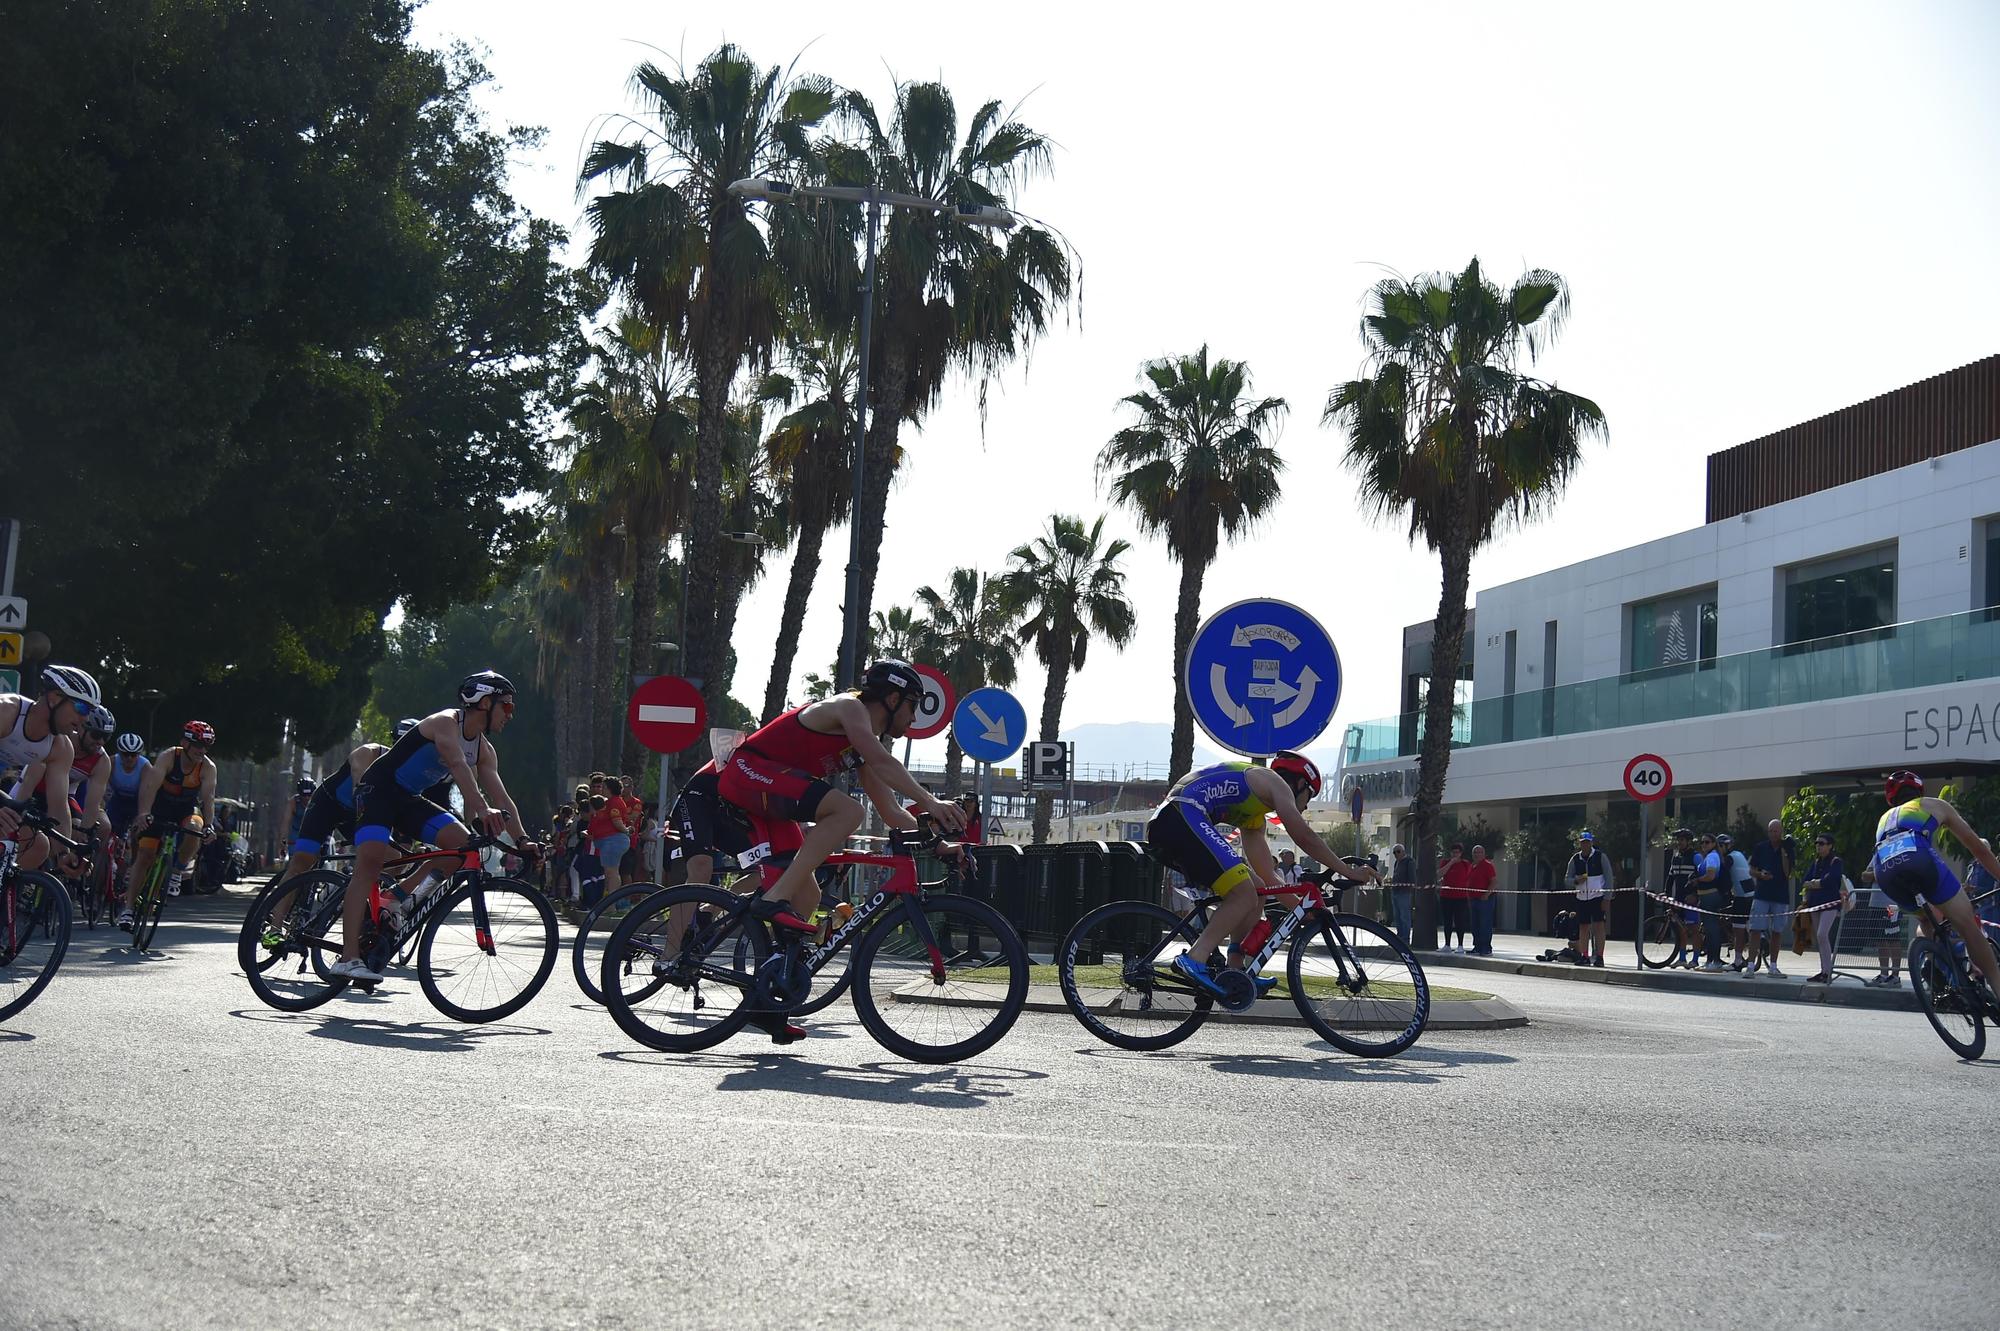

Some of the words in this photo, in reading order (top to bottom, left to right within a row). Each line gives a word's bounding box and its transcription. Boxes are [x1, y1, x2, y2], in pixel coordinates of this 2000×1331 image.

[920, 691, 939, 715] 0
[736, 758, 774, 785] Cartagena
[1034, 743, 1062, 775] P
[1633, 770, 1662, 786] 40
[1130, 824, 1141, 838] P
[747, 848, 761, 862] 30
[1887, 840, 1905, 853] 72
[1882, 854, 1910, 873] JOSE
[393, 875, 454, 946] SPECIALIZED
[805, 892, 885, 971] PINARELLO
[1246, 892, 1317, 976] TREK
[1067, 940, 1121, 1038] BONTRAGER
[1396, 952, 1426, 1045] BONTRAGER
